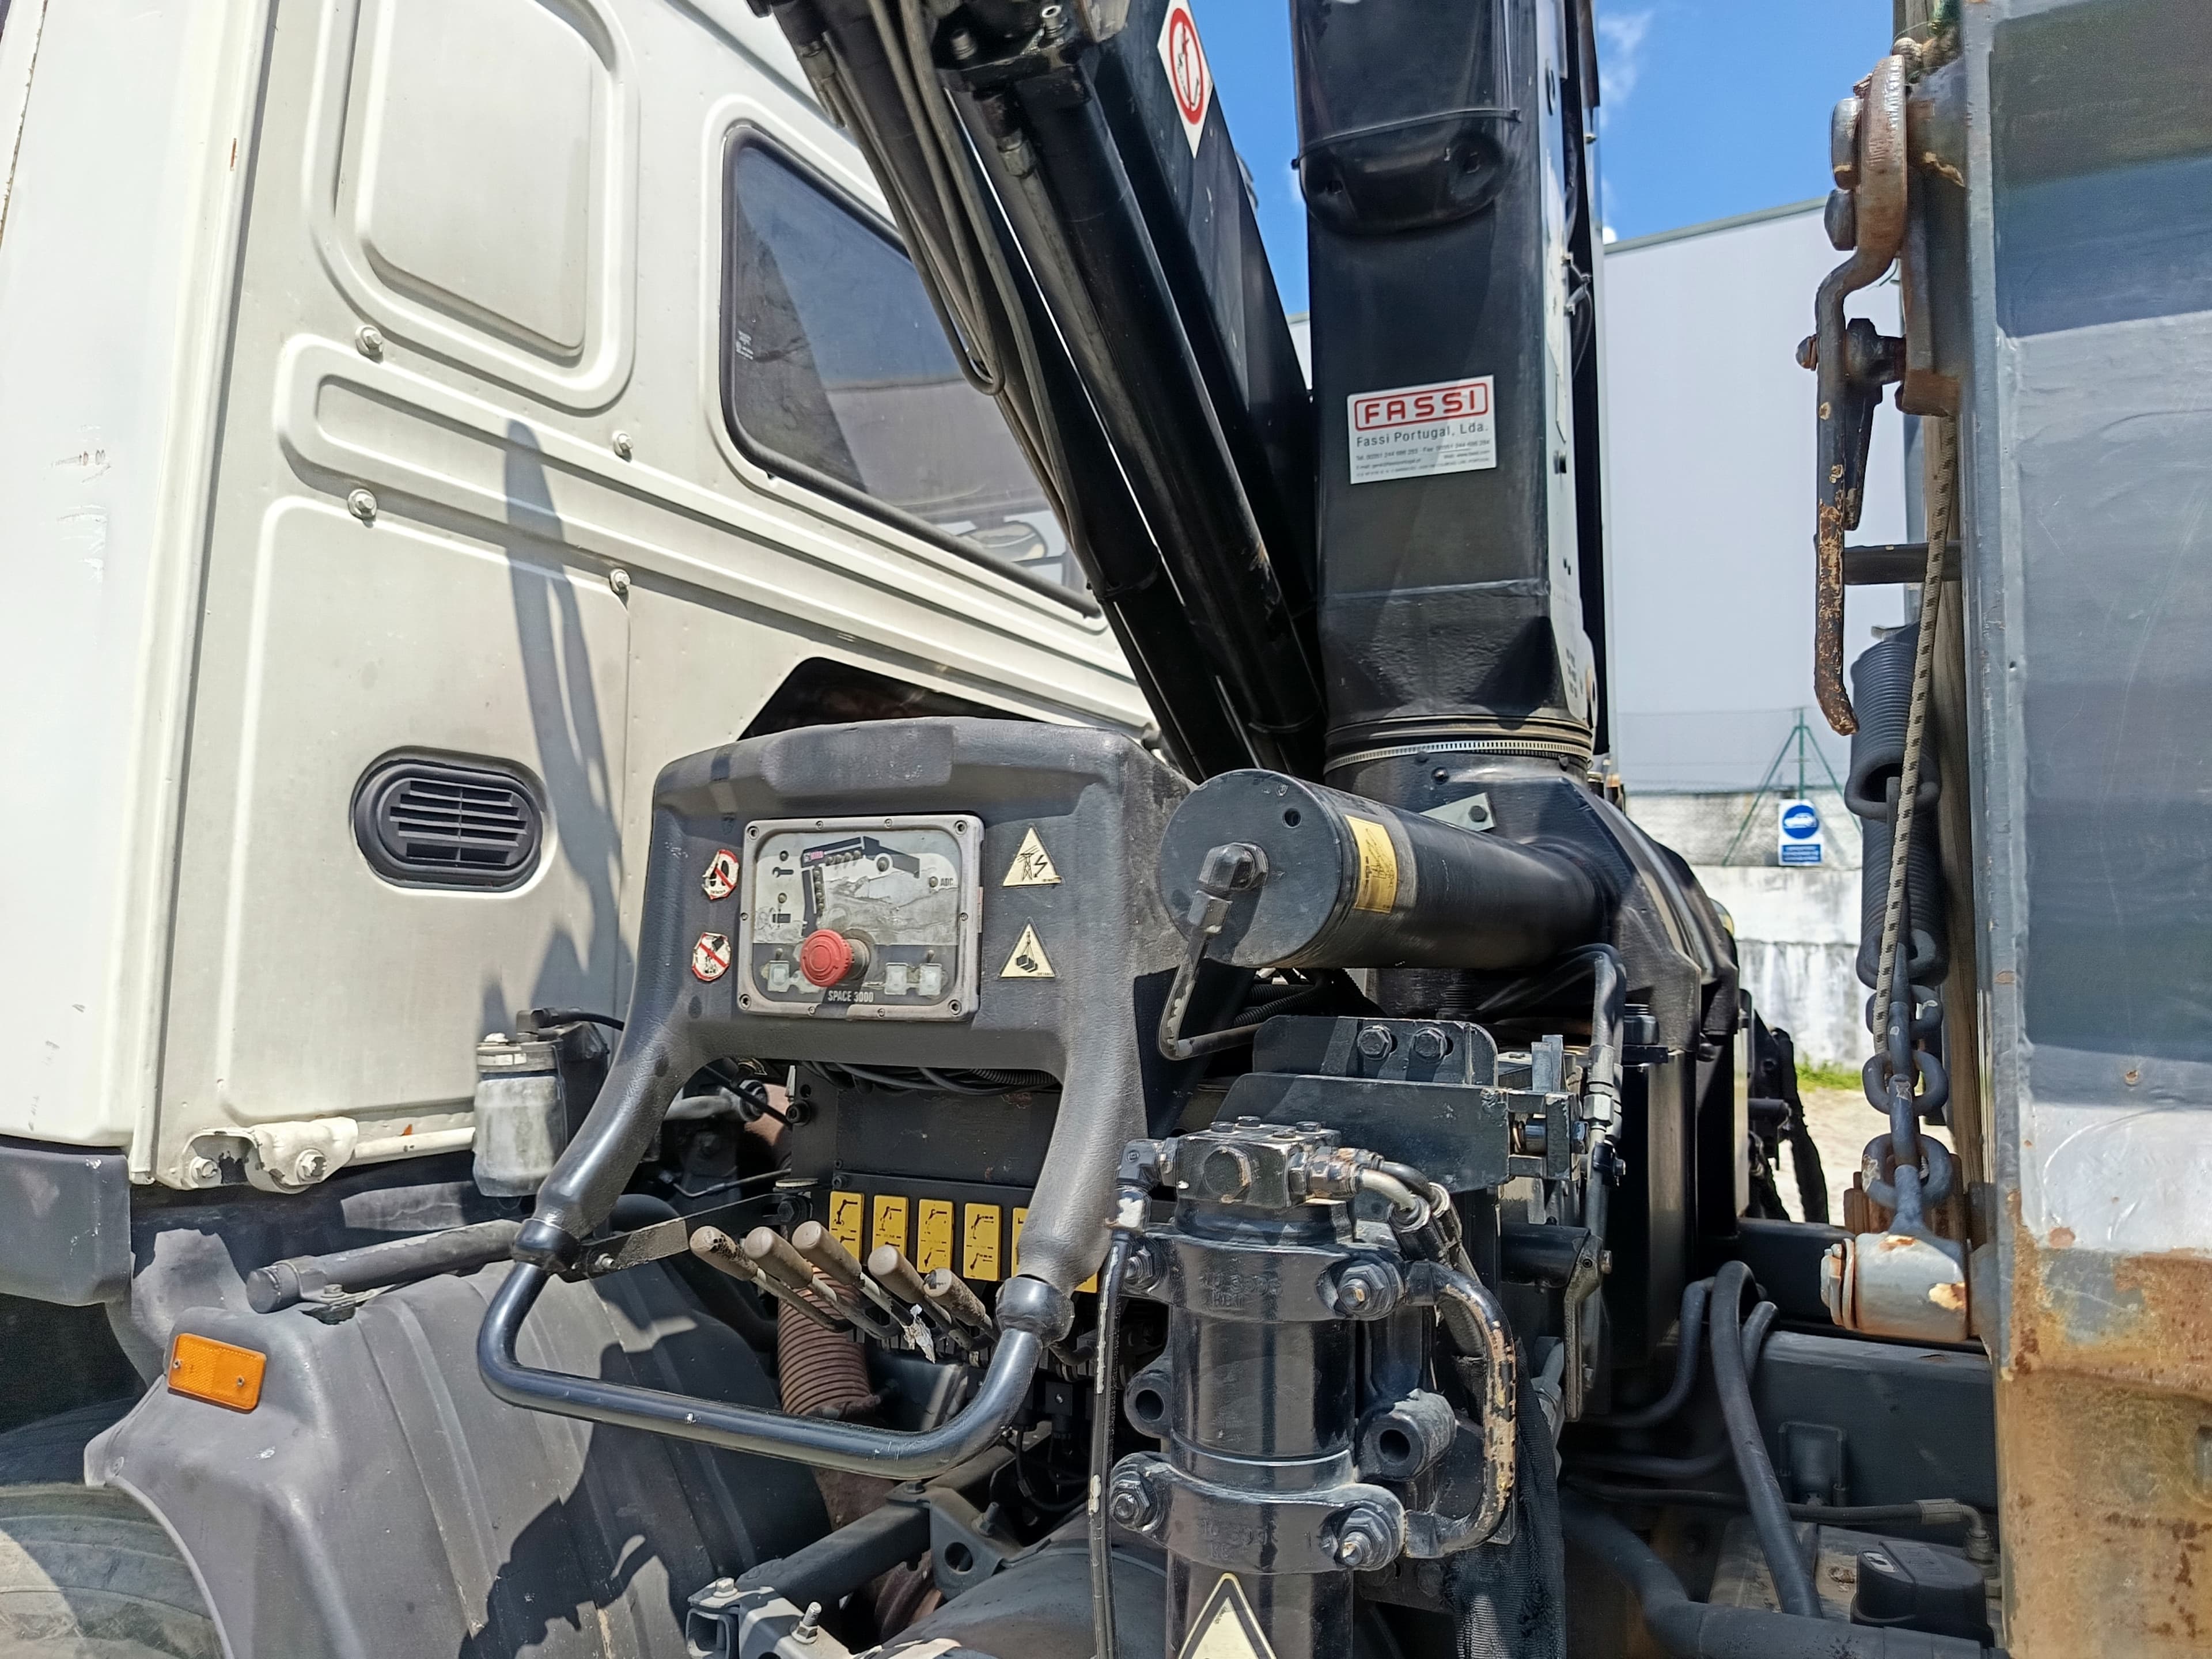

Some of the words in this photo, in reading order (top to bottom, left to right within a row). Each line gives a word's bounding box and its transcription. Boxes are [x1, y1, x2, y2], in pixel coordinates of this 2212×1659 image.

[1365, 390, 1475, 424] FASSI
[1357, 434, 1389, 447] Fassi
[1460, 422, 1489, 434] Lda.
[941, 877, 953, 887] ADC
[828, 990, 852, 1002] SPACE
[854, 991, 874, 1002] 3000
